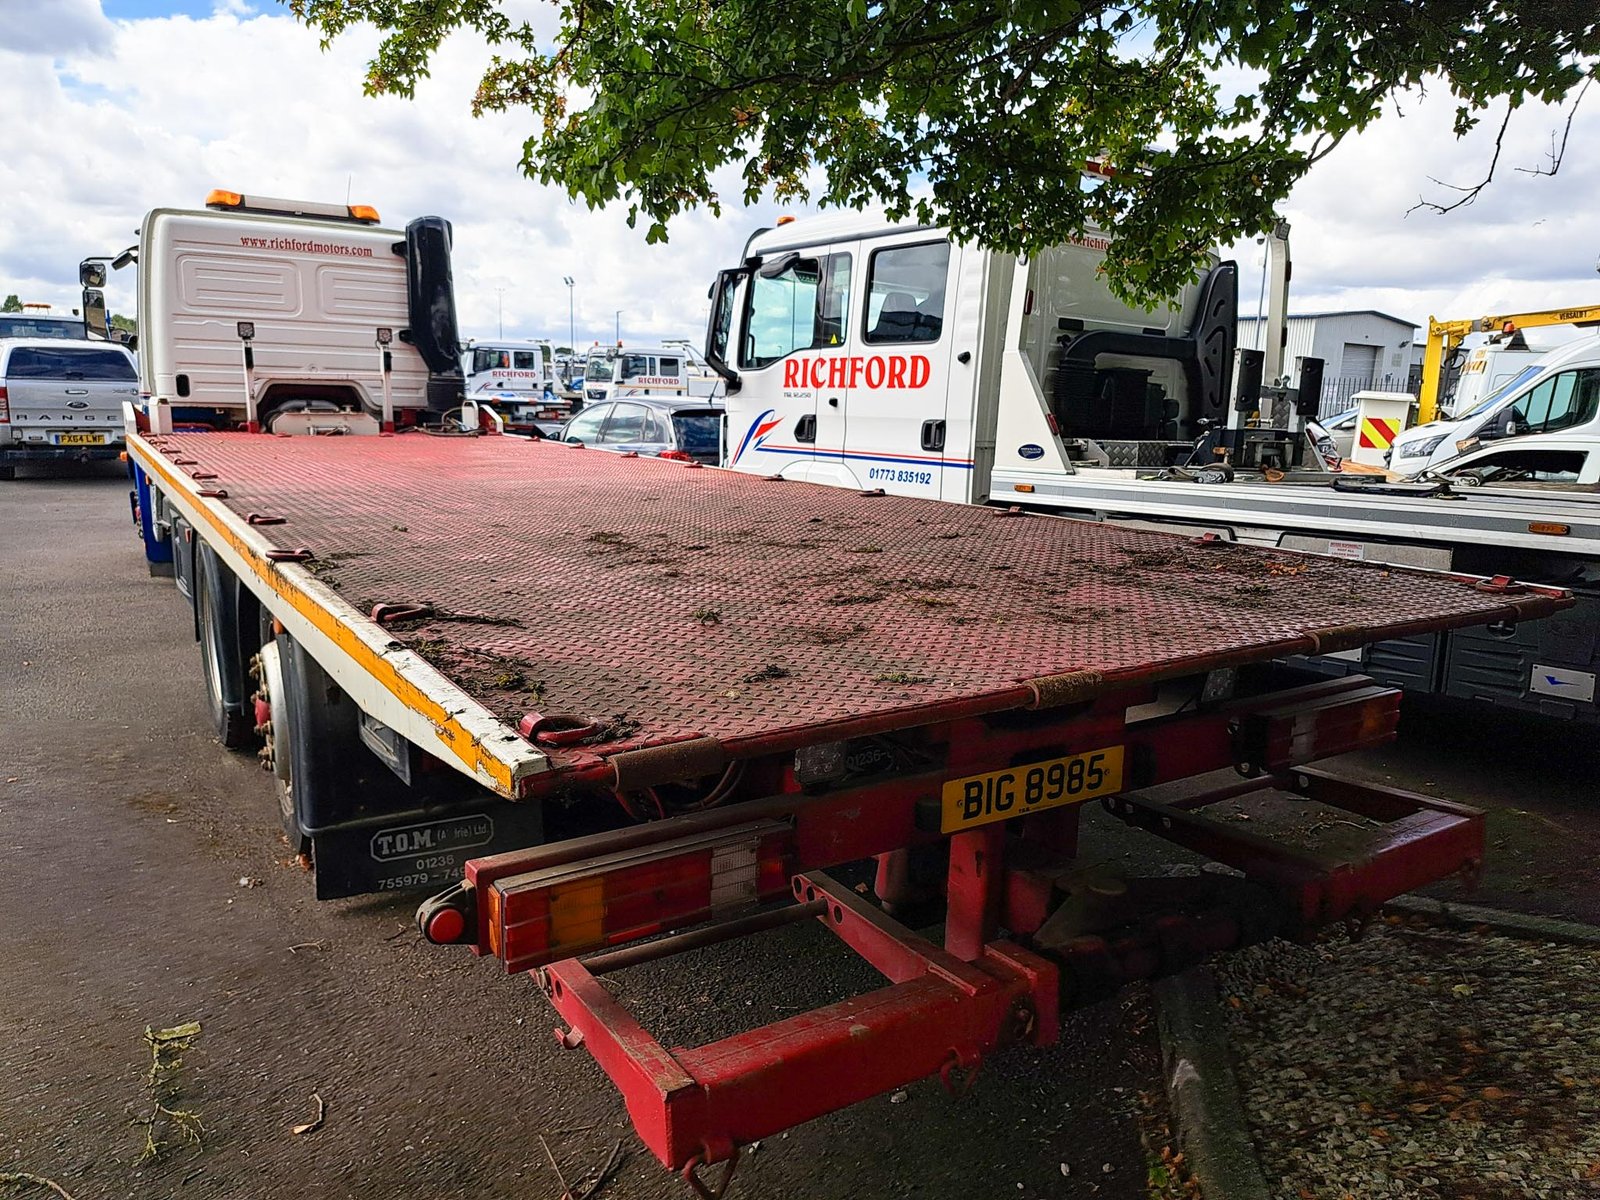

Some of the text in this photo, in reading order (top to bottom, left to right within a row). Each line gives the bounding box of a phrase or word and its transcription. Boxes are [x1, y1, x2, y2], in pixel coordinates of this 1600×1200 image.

[240, 236, 373, 257] www.richfordmotors.com
[492, 370, 536, 378] RICHFORD
[638, 377, 680, 385] RICHFORD
[783, 355, 931, 390] RICHFORD
[16, 413, 118, 421] RANGE
[869, 467, 932, 485] 01773 835192
[963, 754, 1105, 820] BIG 8985
[377, 828, 436, 856] T.O.M.
[416, 854, 455, 870] 01236
[377, 872, 429, 890] 755979
[443, 865, 465, 880] 749
